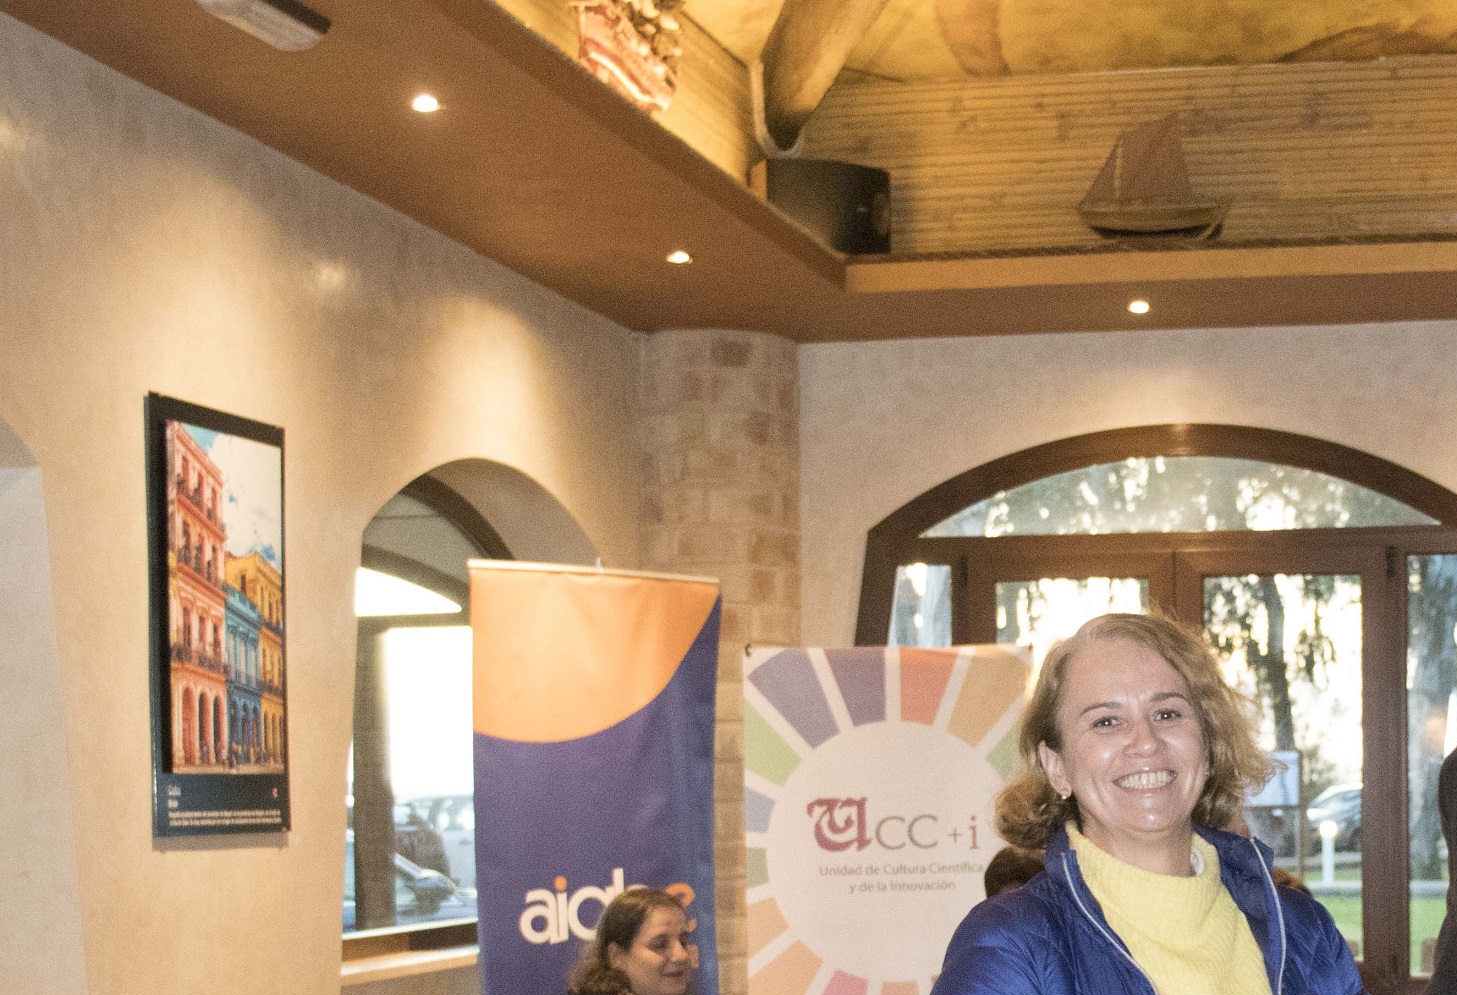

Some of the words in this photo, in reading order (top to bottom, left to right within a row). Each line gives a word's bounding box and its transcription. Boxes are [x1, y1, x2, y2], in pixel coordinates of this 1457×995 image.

[819, 864, 863, 876] Unidad
[865, 864, 881, 876] de
[883, 862, 926, 875] Cultura
[928, 860, 984, 874] Científica
[849, 884, 857, 895] y
[859, 880, 875, 892] de
[877, 880, 887, 892] la
[890, 879, 956, 892] Innovación
